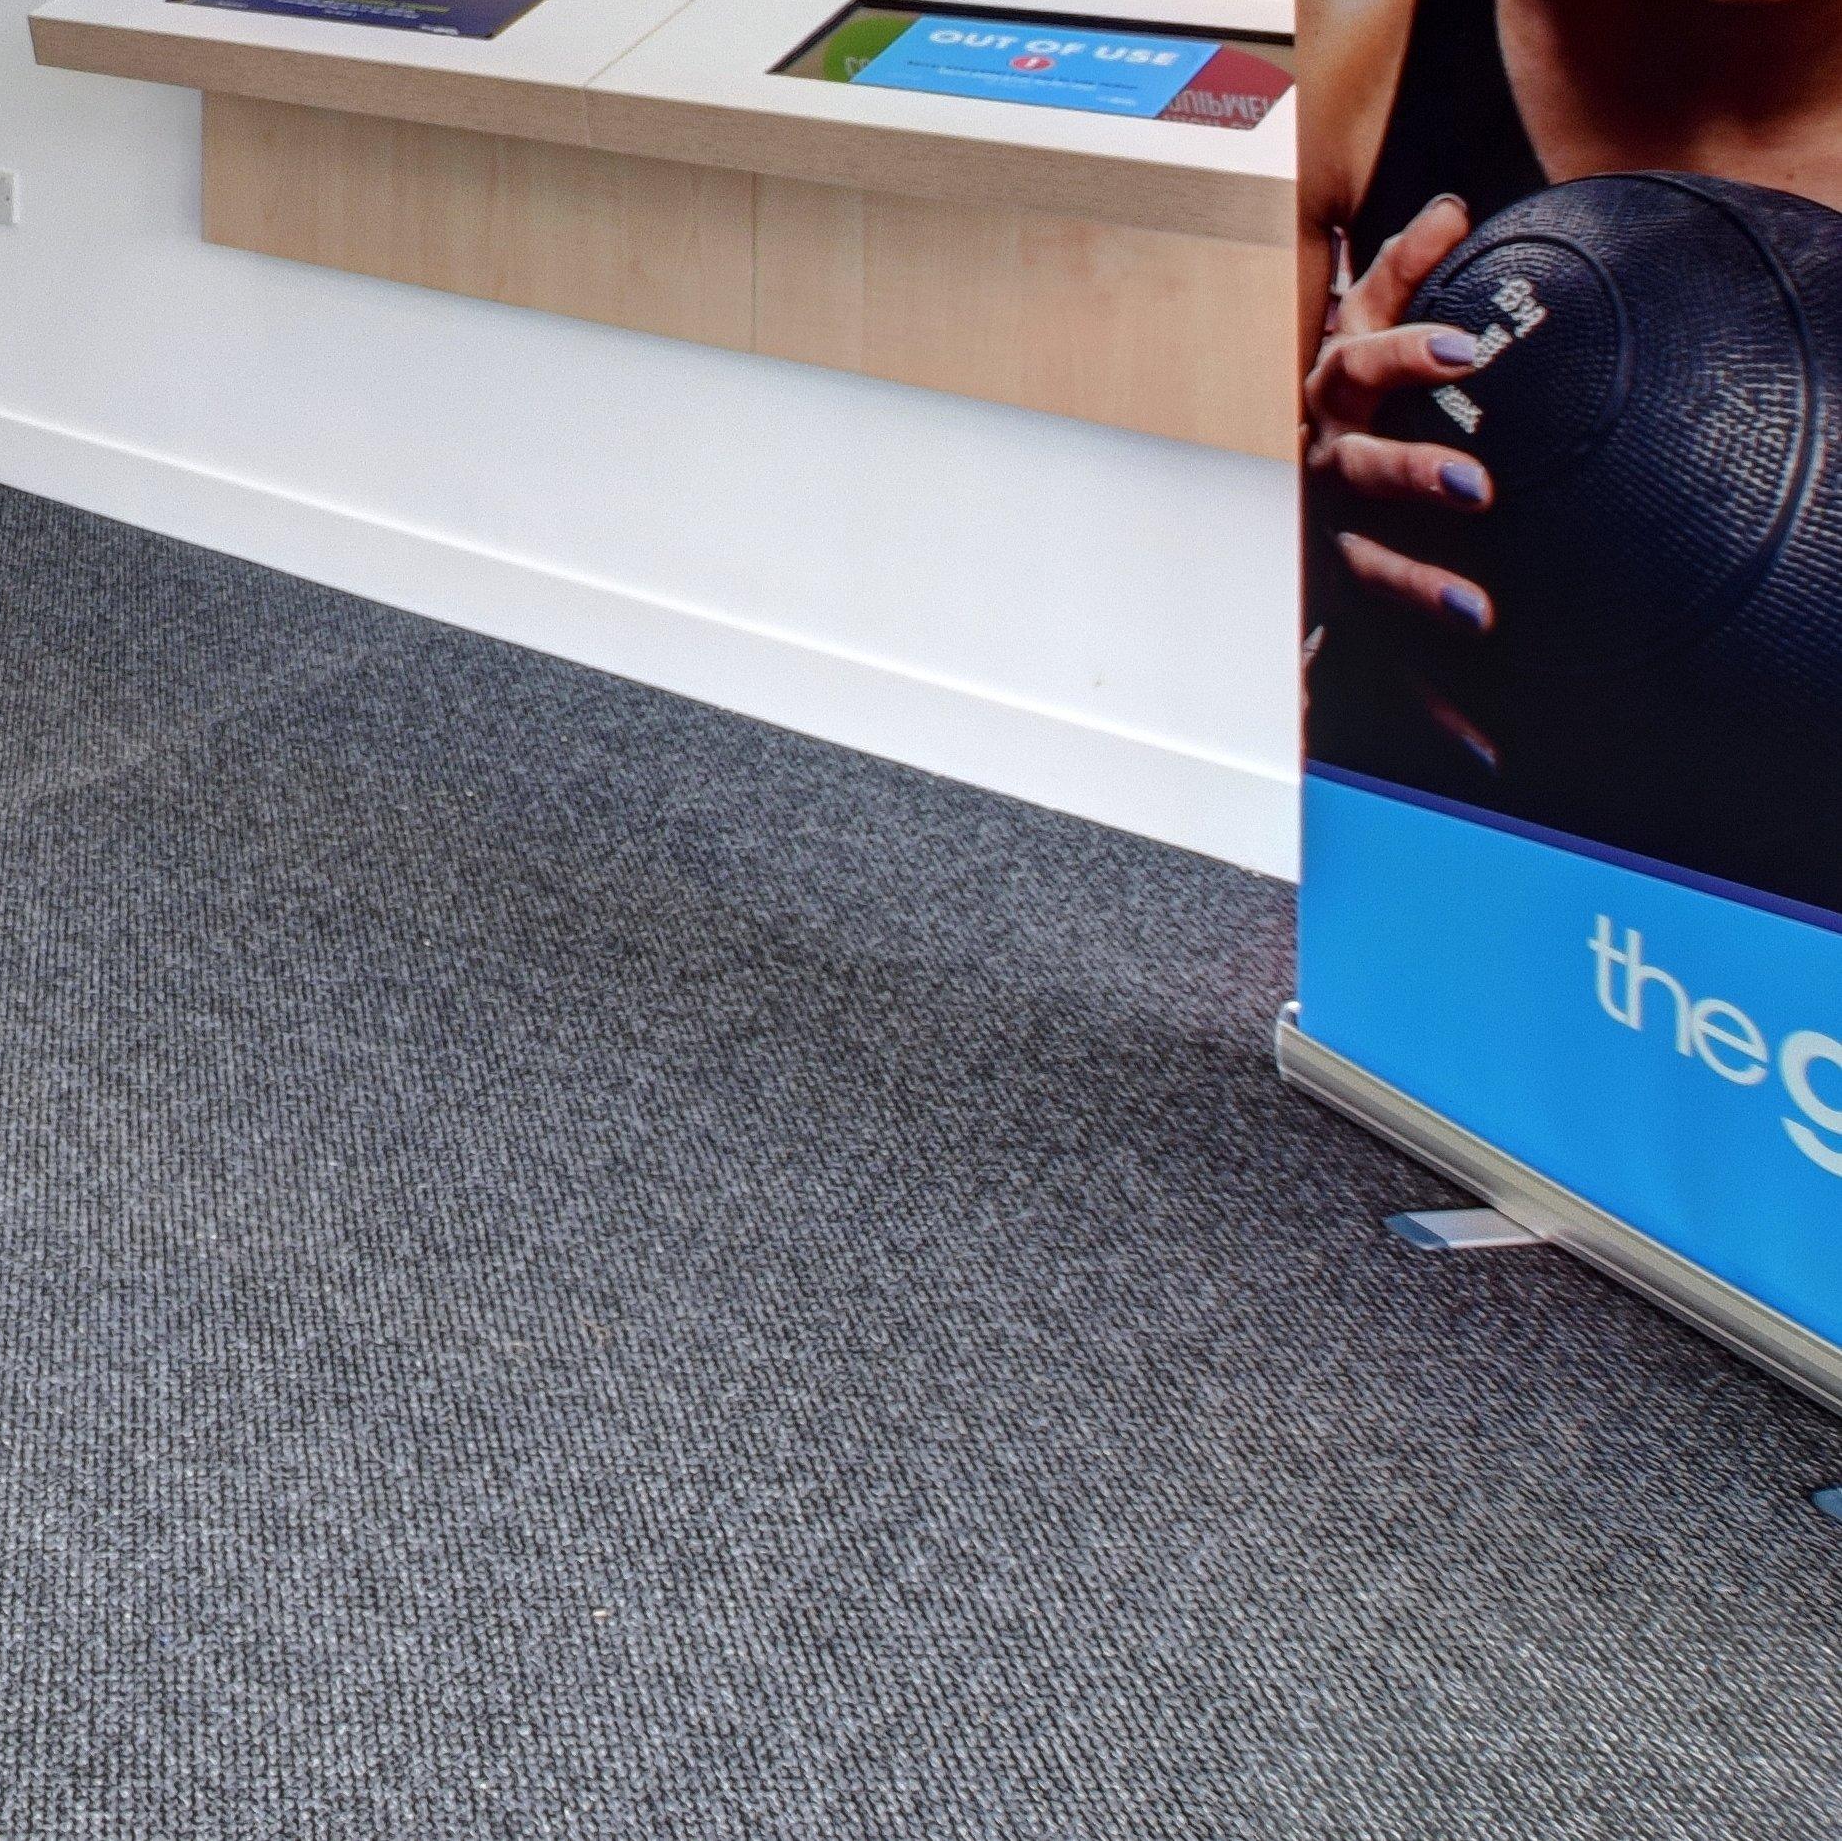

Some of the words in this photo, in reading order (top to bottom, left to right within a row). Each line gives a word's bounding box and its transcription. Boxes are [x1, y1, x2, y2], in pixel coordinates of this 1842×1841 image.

[929, 29, 1016, 49] OUT
[1024, 38, 1087, 56] OF
[1095, 44, 1180, 67] USE
